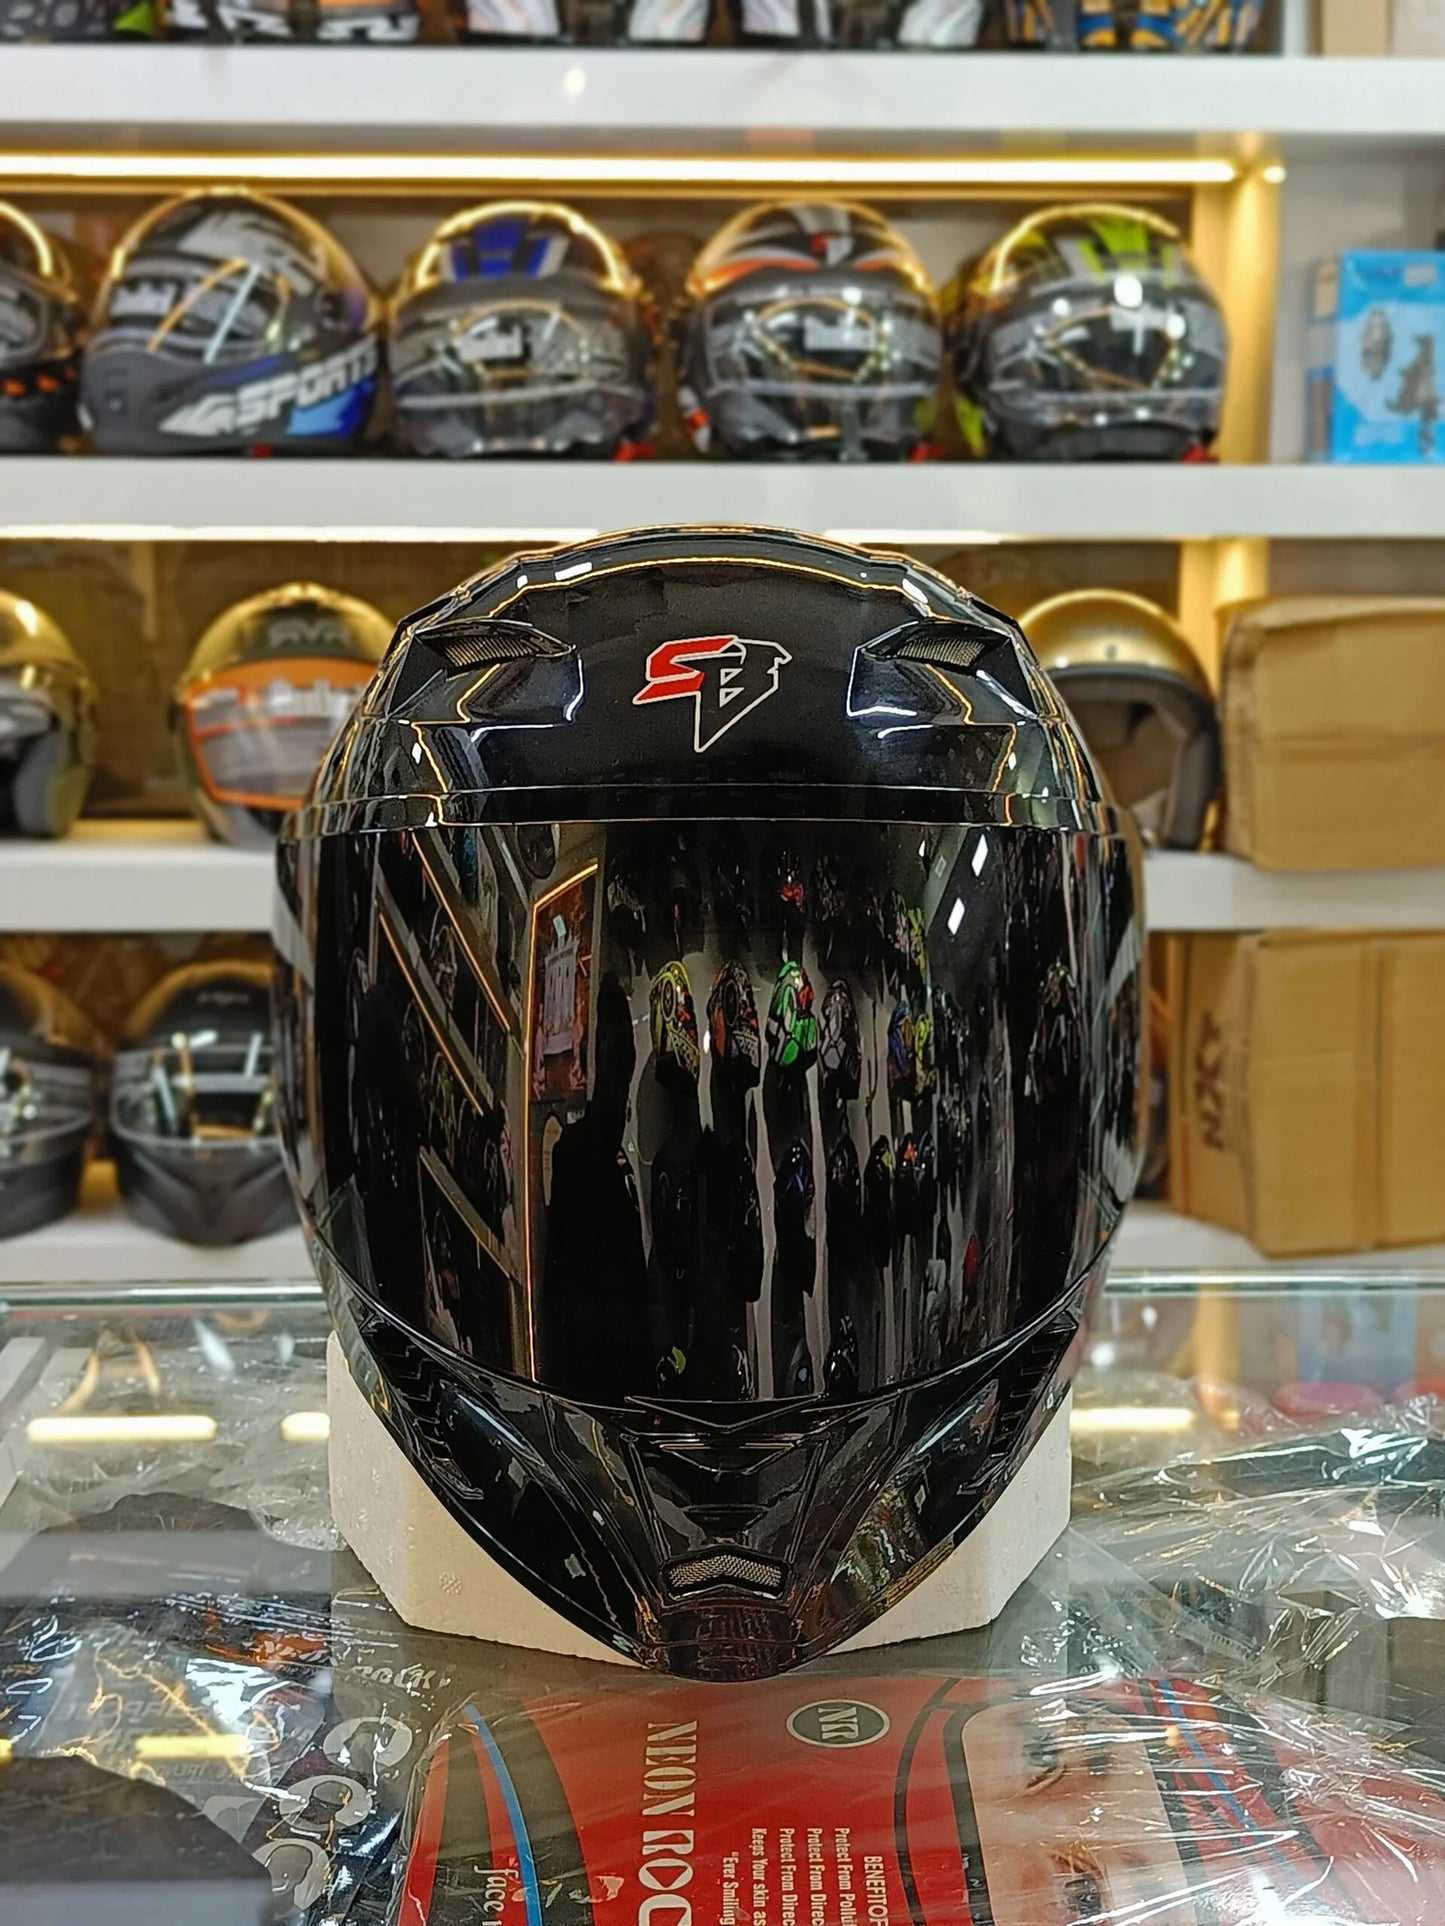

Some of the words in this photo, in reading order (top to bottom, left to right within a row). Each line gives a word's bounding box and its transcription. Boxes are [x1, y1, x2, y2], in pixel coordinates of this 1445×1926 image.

[641, 1720, 698, 1818] NEON
[748, 1827, 768, 1857] Keeps
[779, 1827, 795, 1863] Protect
[806, 1827, 824, 1863] Protect
[834, 1827, 852, 1862] Protect
[752, 1858, 768, 1881] Your
[780, 1864, 797, 1891] From
[809, 1864, 826, 1891] From
[837, 1864, 855, 1890] From
[473, 1864, 519, 1913] face
[752, 1883, 770, 1908] skin
